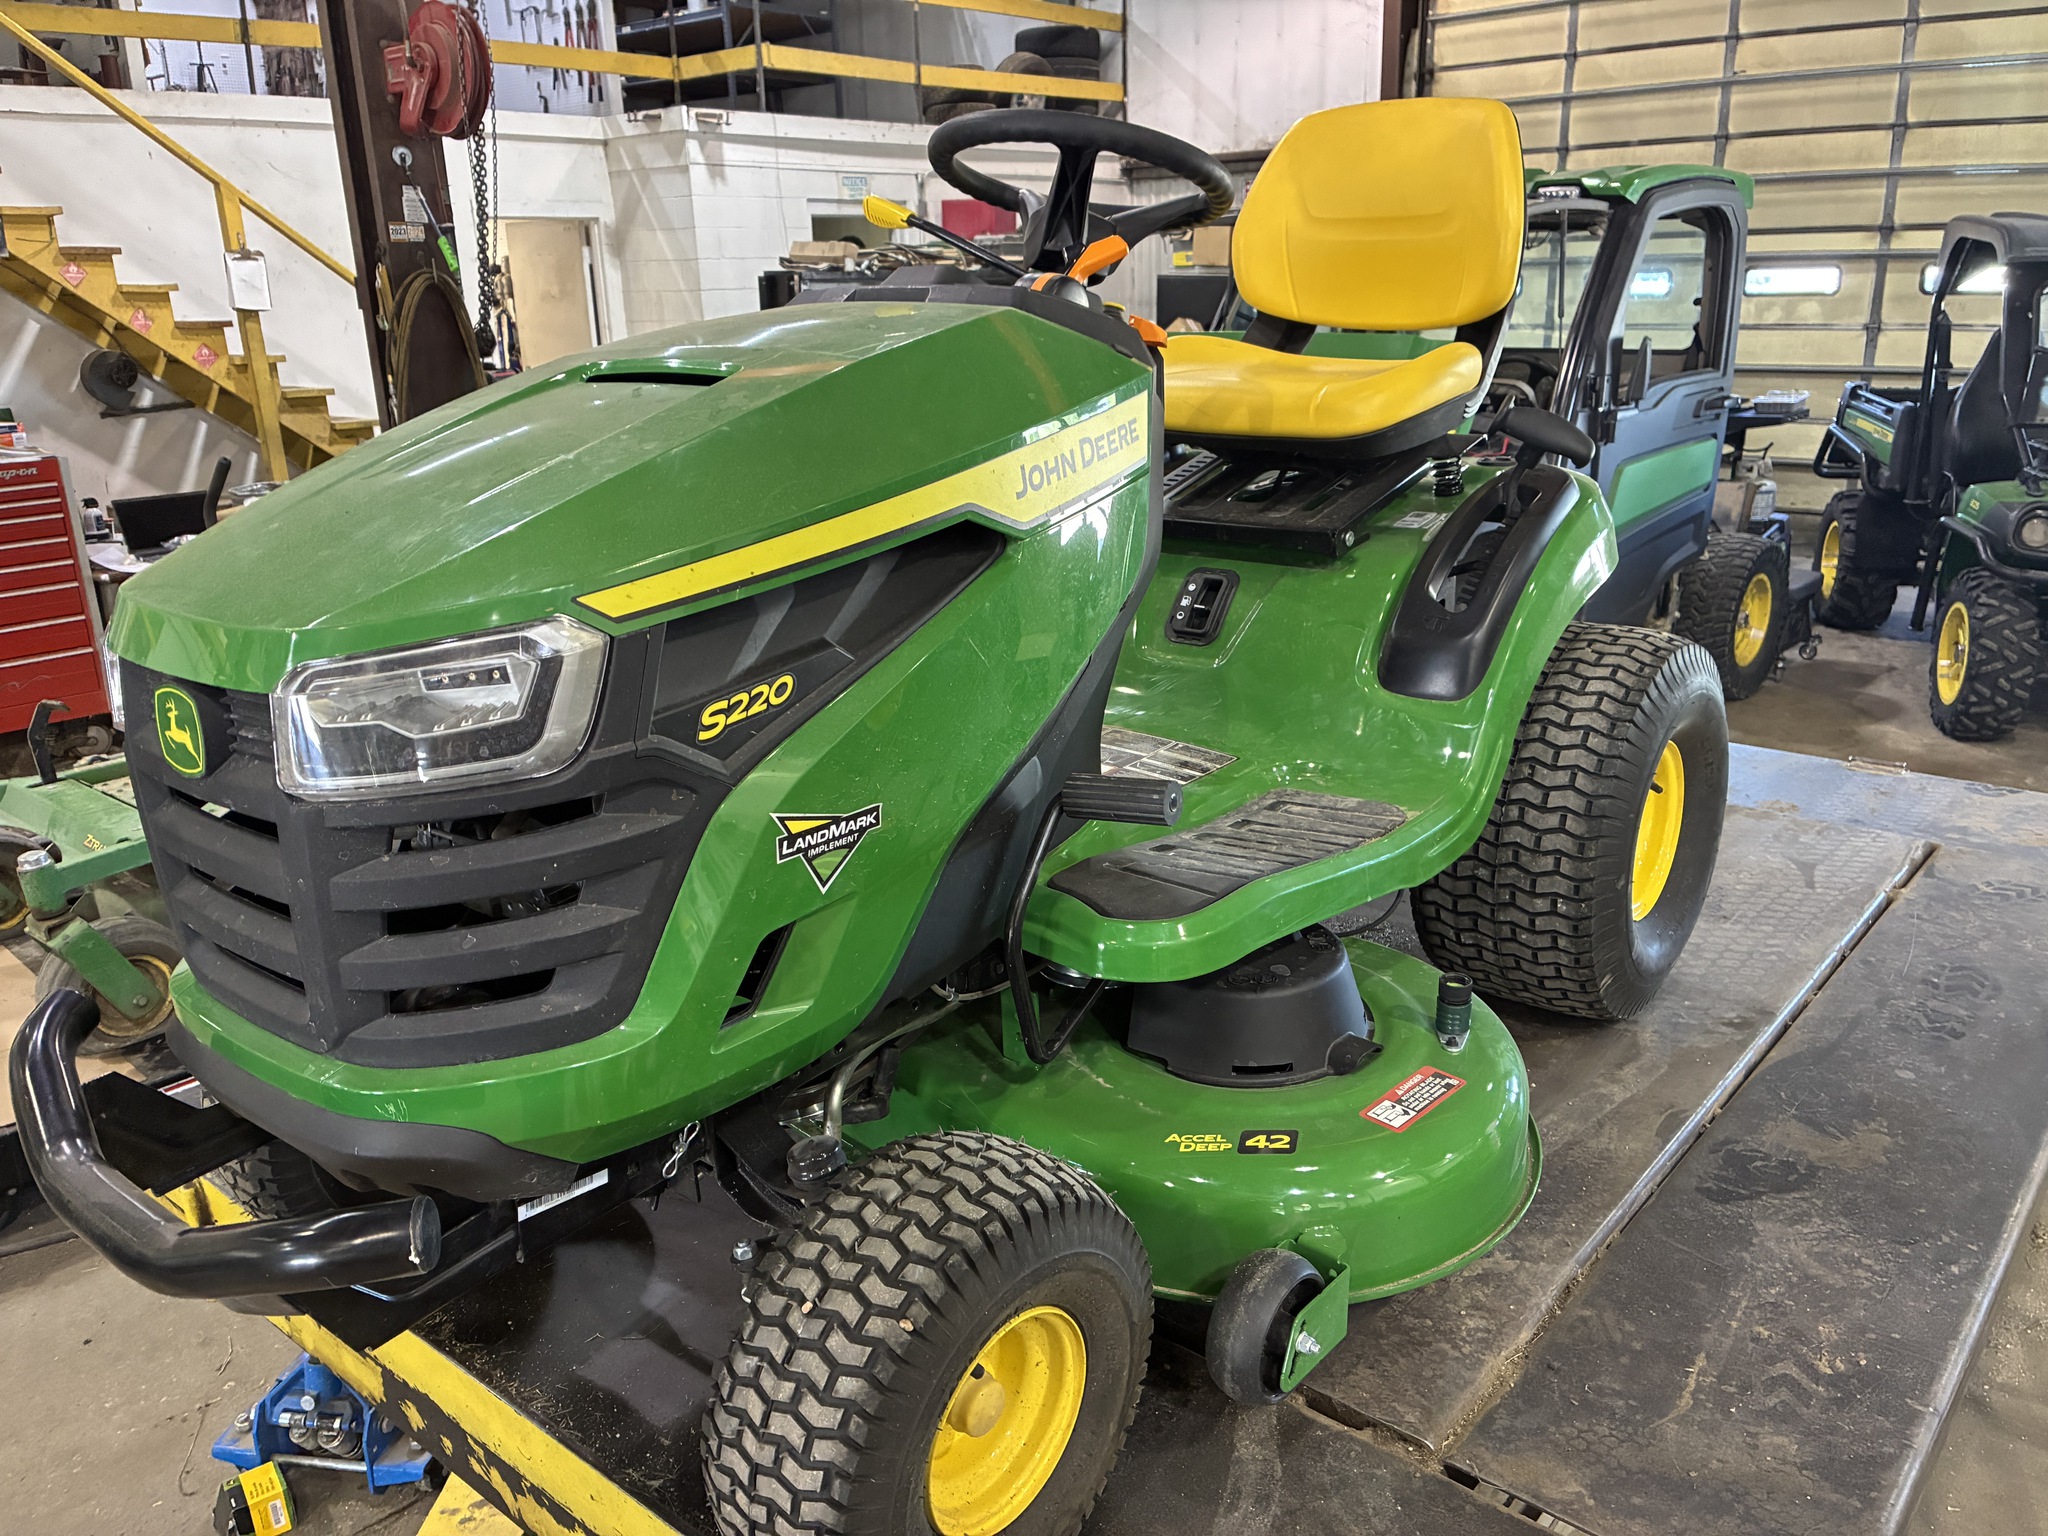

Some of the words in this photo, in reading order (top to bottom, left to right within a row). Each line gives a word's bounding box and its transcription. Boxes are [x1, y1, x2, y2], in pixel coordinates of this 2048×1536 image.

[1016, 448, 1076, 500] JOHN
[1079, 418, 1139, 469] DEERE
[698, 674, 794, 741] S220
[807, 832, 860, 858] IMPLEMENT
[1400, 1074, 1425, 1091] DANGER
[1164, 1133, 1227, 1143] ACCEL
[1245, 1134, 1291, 1149] 42
[1179, 1142, 1233, 1152] DEEP
